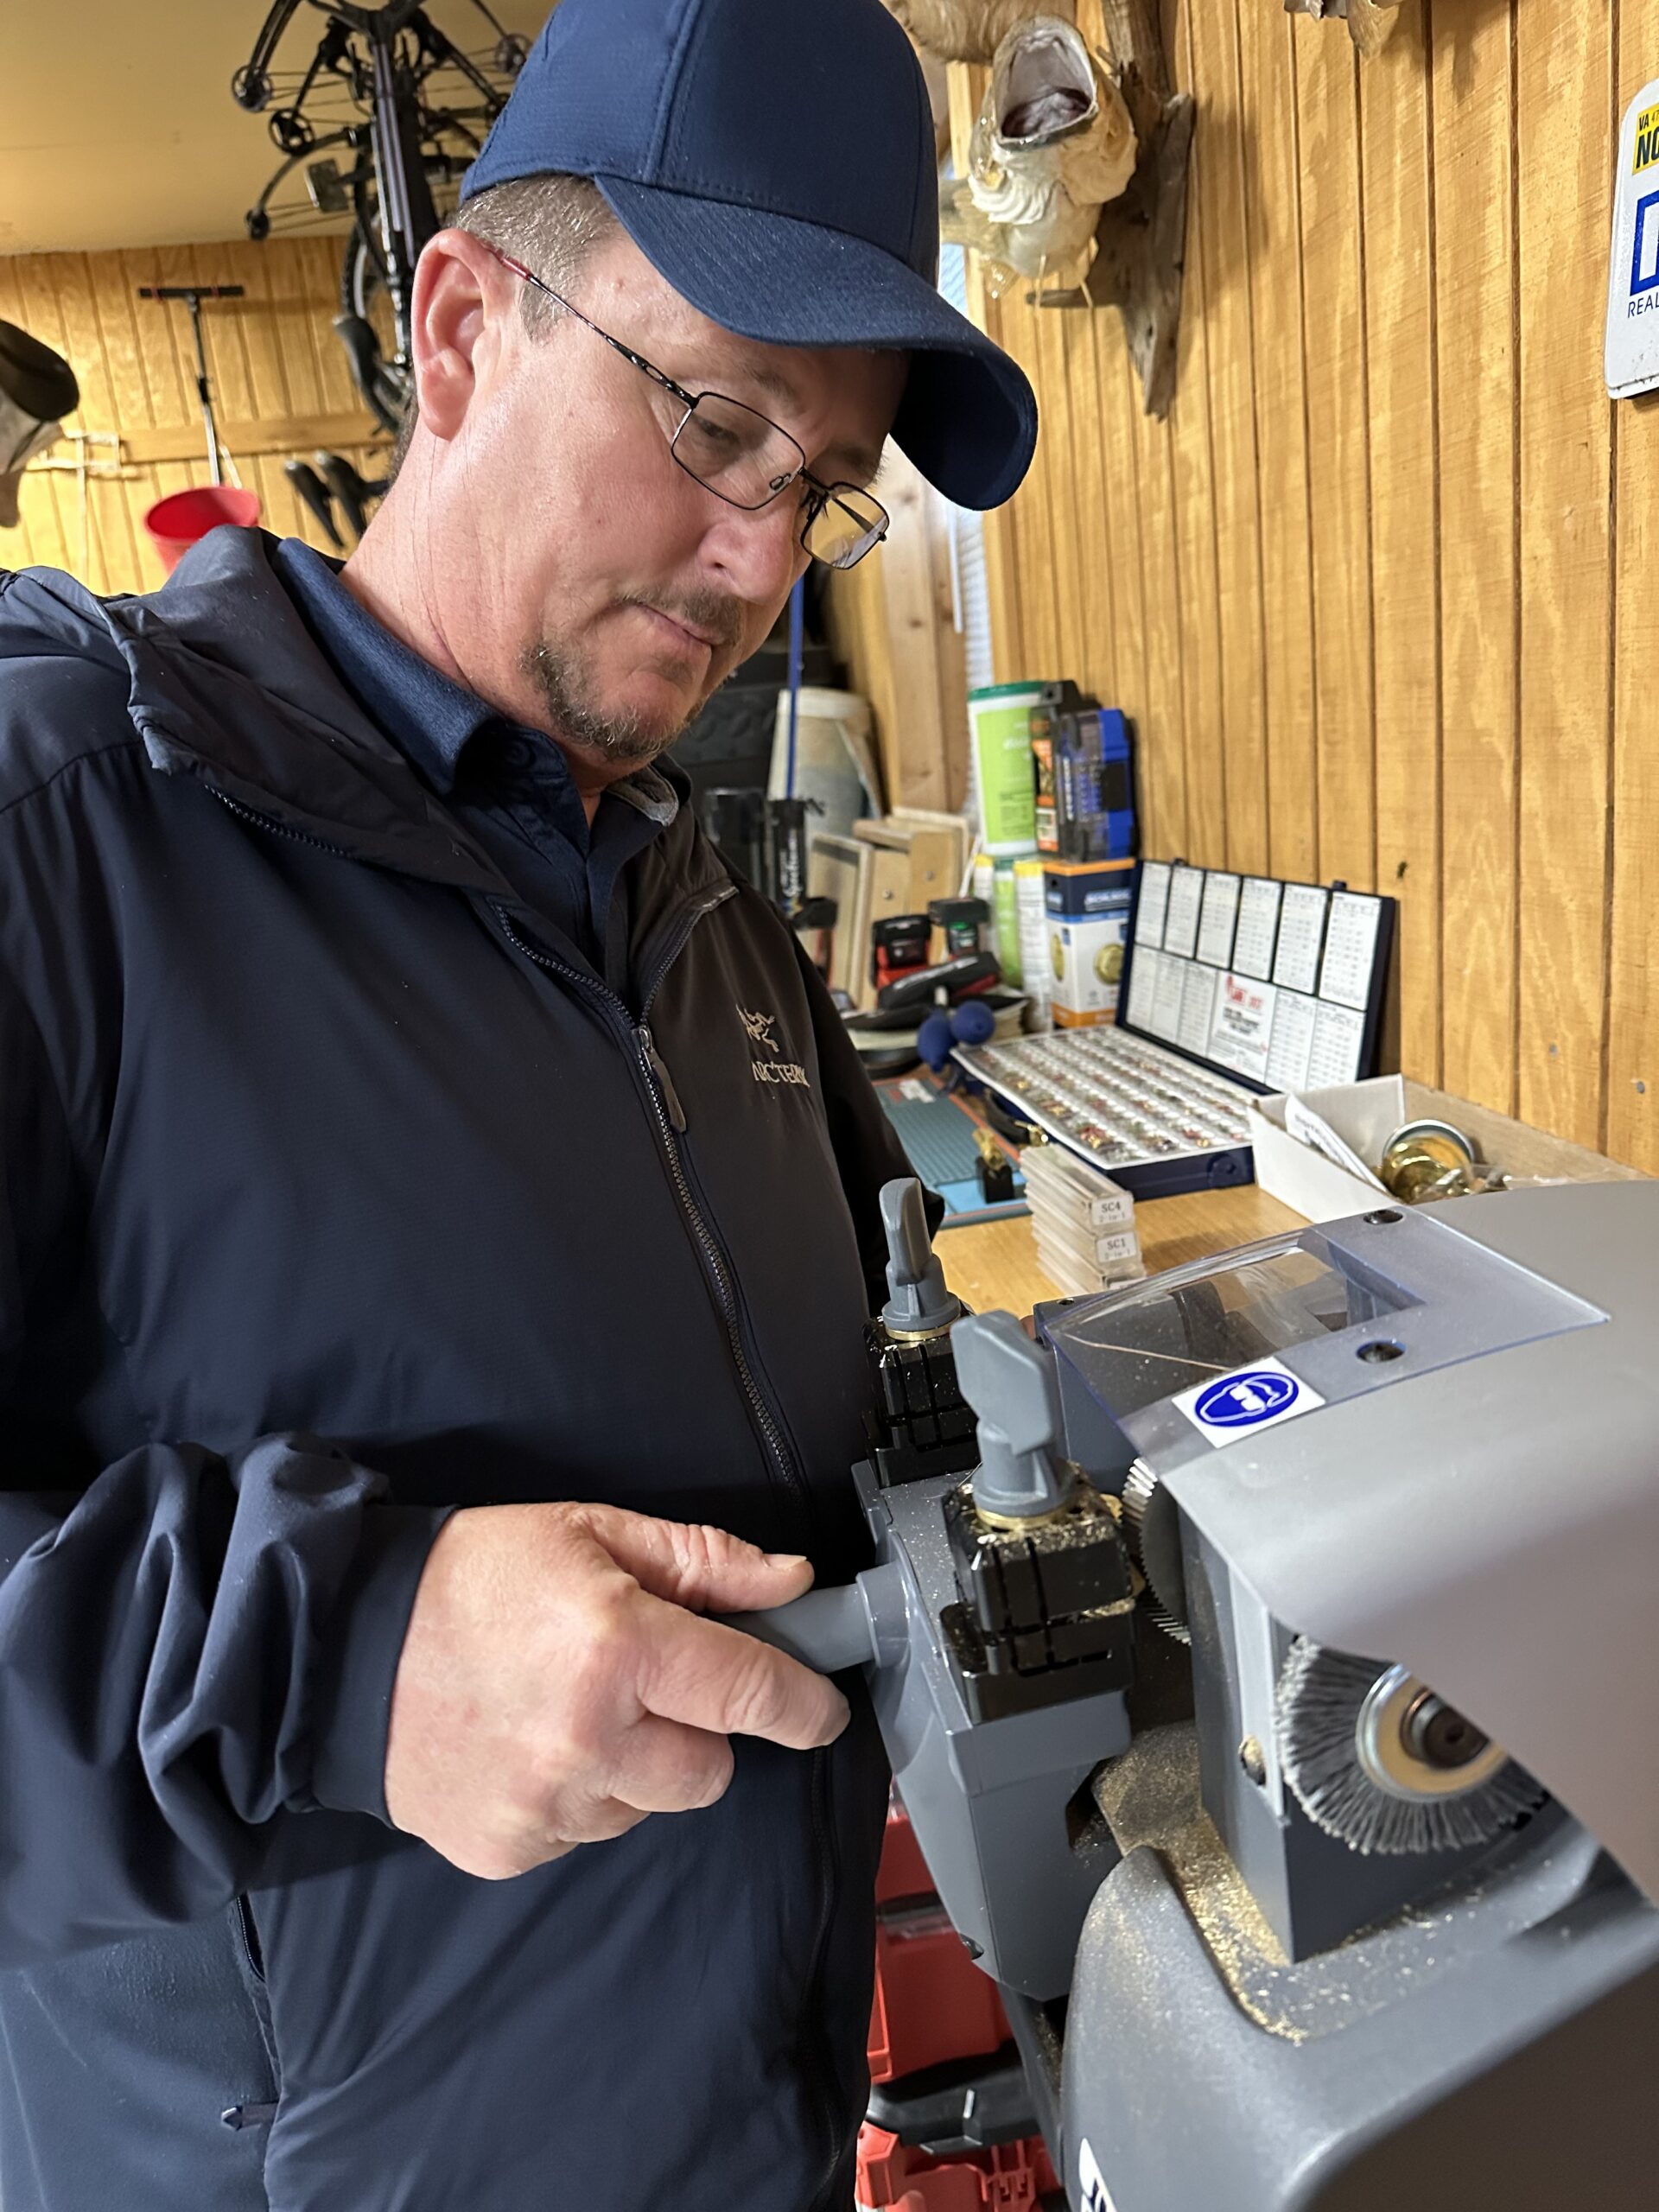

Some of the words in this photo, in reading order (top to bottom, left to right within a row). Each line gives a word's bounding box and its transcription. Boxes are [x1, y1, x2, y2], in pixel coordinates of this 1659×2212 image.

[1639, 113, 1649, 131] VA
[1101, 1201, 1121, 1212] SC4
[1107, 1237, 1127, 1250] SC1
